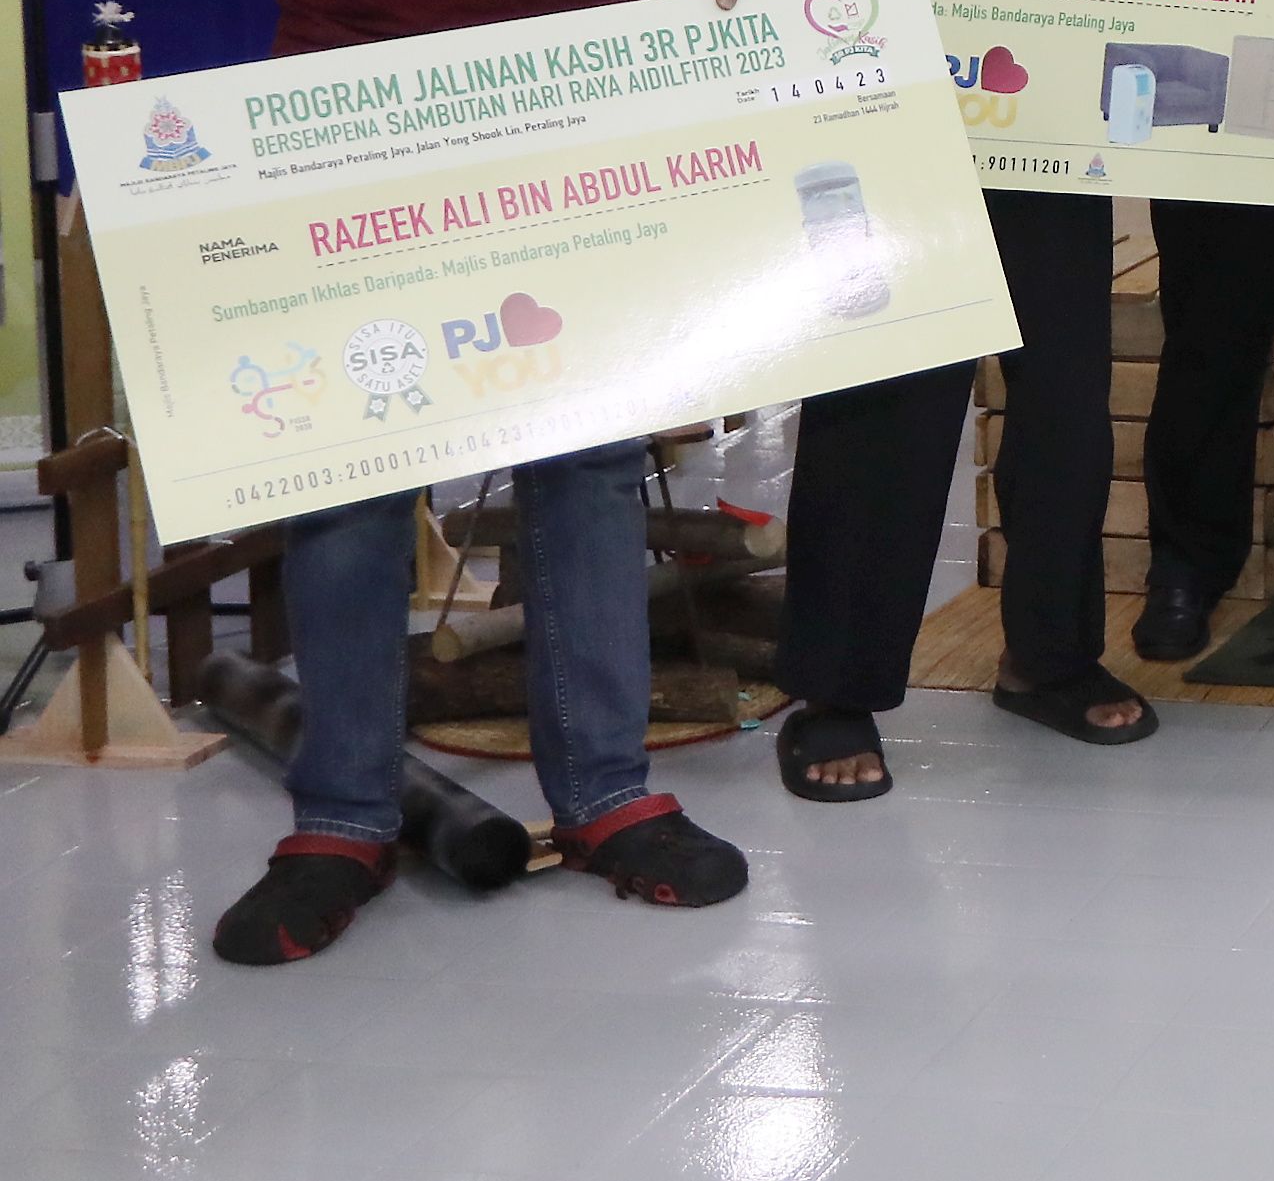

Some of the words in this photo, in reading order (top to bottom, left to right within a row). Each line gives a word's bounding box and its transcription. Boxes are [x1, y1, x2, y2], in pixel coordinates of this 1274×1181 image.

[244, 73, 402, 129] PROGRAM
[413, 51, 538, 101] JALINAN
[544, 35, 633, 78] KASIH
[639, 28, 679, 62] 3R
[683, 12, 779, 55] PJKITA
[251, 118, 380, 157] BERSEMPENA
[385, 93, 506, 135] SAMBUTAN
[511, 83, 564, 113] HARI
[568, 73, 623, 103] RAYA
[629, 54, 732, 93] AIDILFITRI
[735, 45, 785, 74] 2023
[308, 202, 433, 256] RAZEEK
[443, 191, 490, 231] ALI
[496, 179, 552, 220] BIN
[563, 161, 661, 208] ABDUL
[666, 140, 762, 187] KARIM
[198, 237, 245, 252] NAMA
[201, 242, 279, 264] PENERIMA
[349, 341, 423, 371] SISA
[440, 312, 501, 359] PJ
